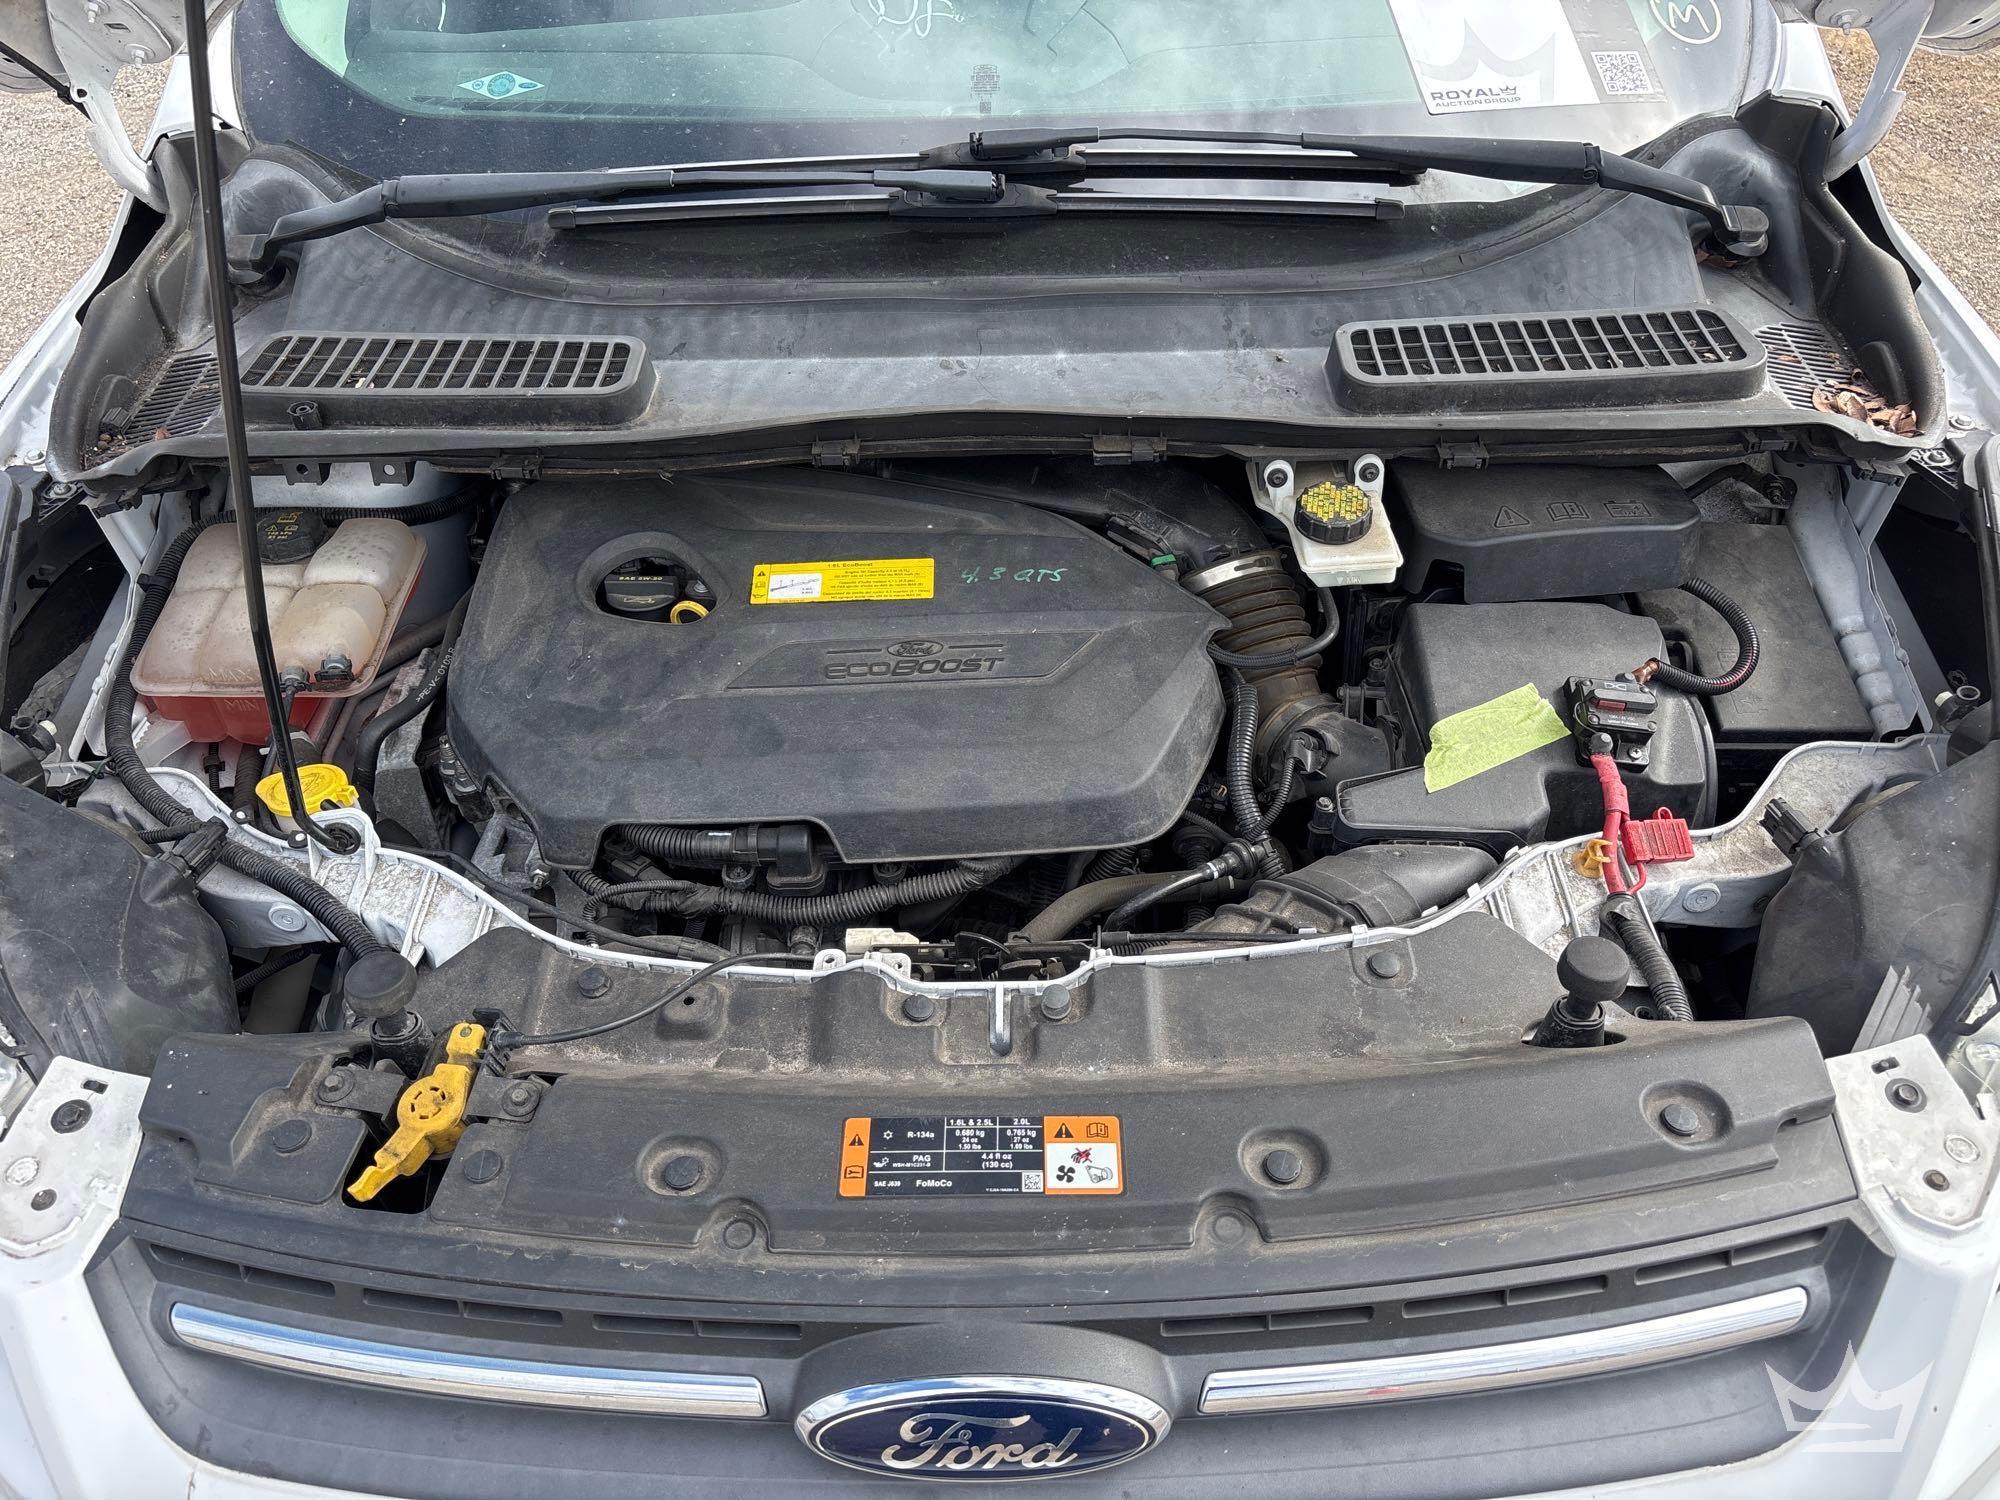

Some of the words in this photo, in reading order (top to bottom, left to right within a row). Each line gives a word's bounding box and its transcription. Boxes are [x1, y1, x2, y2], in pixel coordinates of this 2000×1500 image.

[1668, 1, 1710, 34] M
[1430, 87, 1501, 101] ROYAL
[1435, 98, 1483, 108] AUCTION
[1485, 96, 1521, 104] GROUP
[896, 642, 934, 656] Ford
[975, 1129, 985, 1138] kg
[1026, 1129, 1036, 1137] kg
[982, 1161, 999, 1169] (130
[1000, 1161, 1013, 1169] cc)
[880, 1412, 1083, 1470] Ford
